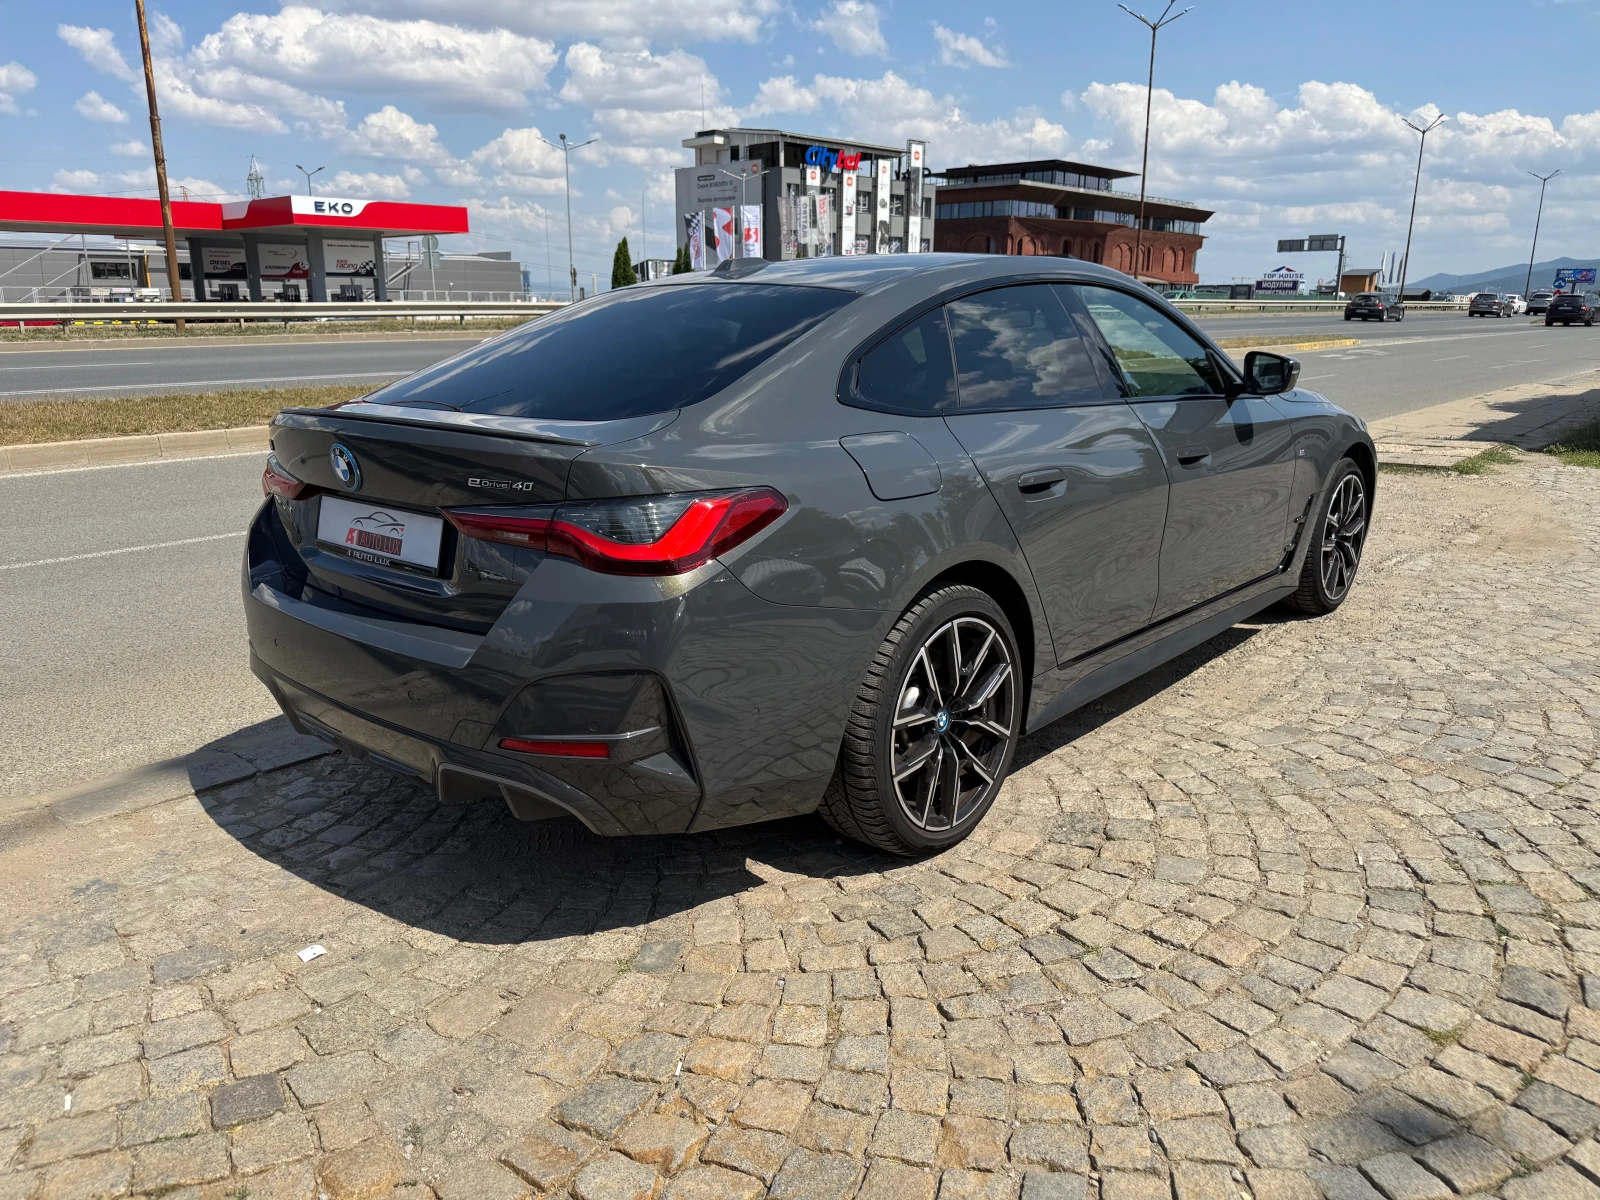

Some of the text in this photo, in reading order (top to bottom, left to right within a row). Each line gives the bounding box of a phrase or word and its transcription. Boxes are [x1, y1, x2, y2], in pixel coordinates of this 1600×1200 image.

[314, 201, 353, 214] EKO
[1261, 281, 1293, 289] МОДУЛНИ
[359, 531, 382, 550] AUTO
[383, 537, 401, 556] LUX
[353, 550, 373, 562] AUTO
[374, 555, 391, 566] LUX
